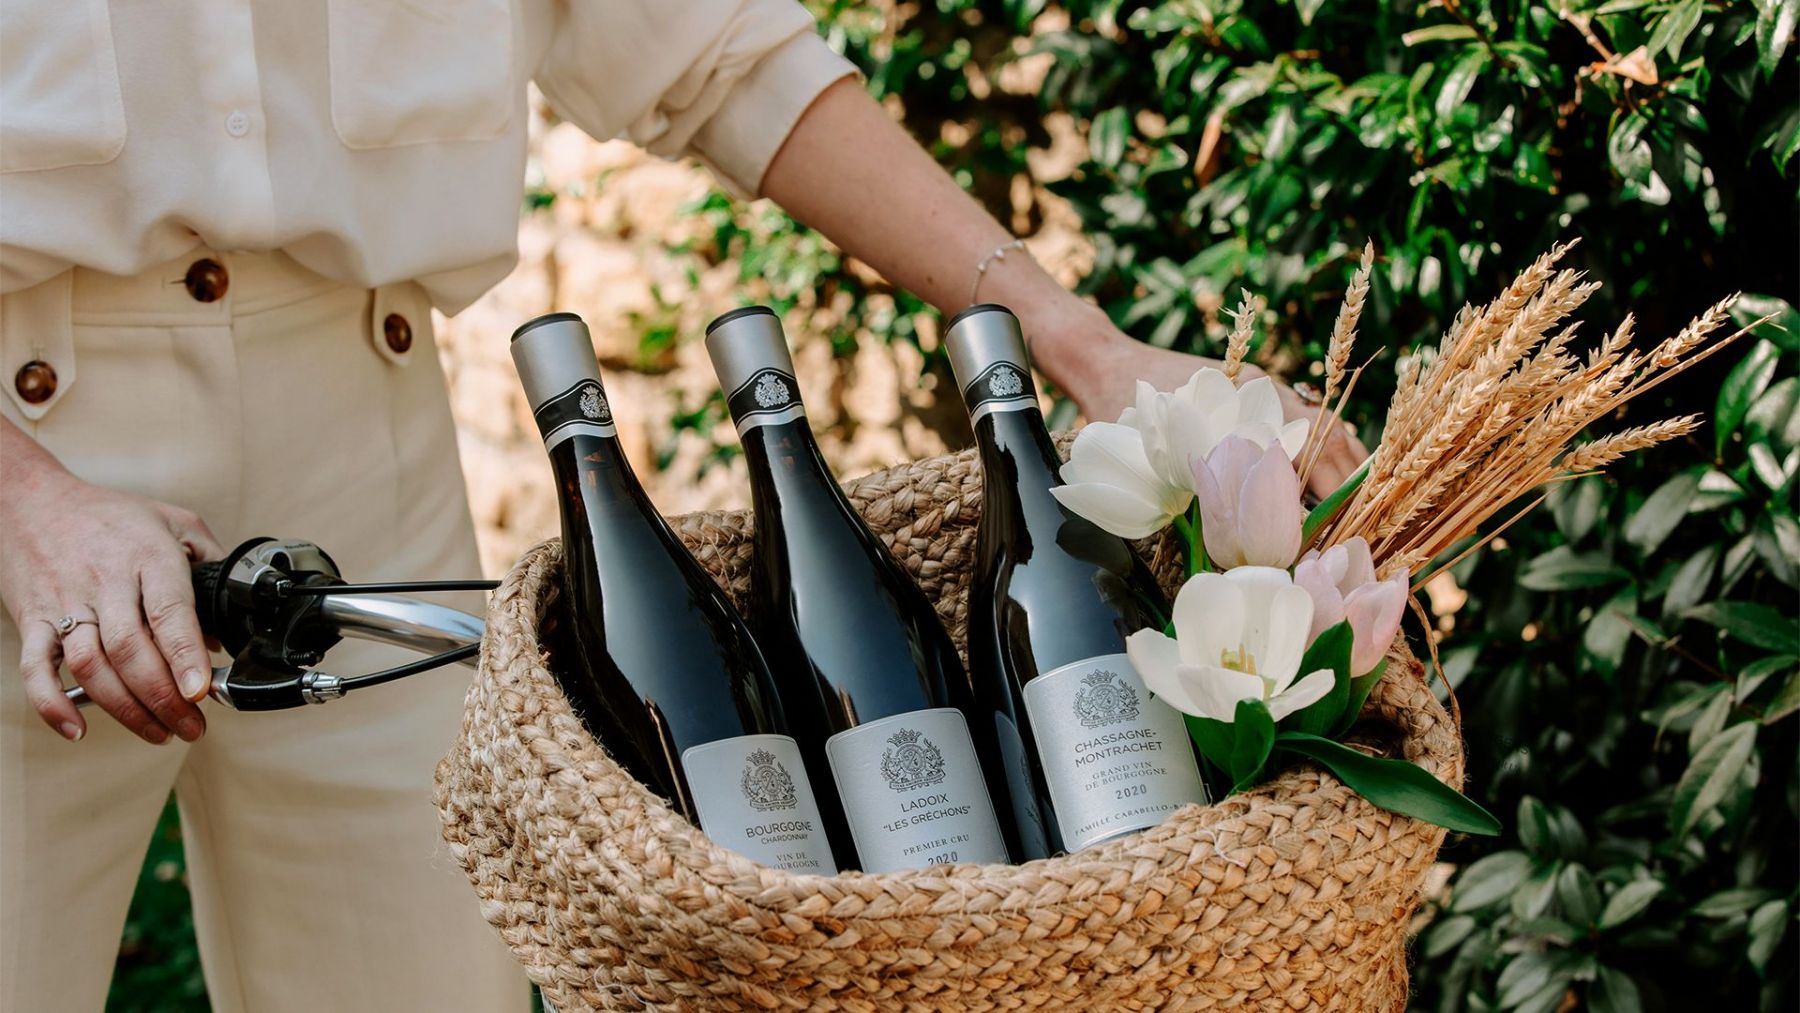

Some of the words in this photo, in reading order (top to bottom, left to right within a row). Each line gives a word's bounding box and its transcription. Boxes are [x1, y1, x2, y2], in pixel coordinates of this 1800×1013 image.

[1075, 729, 1157, 753] CHASSAGNE-
[1075, 741, 1163, 768] MONTRACHET
[1085, 782, 1100, 791] DE
[1103, 767, 1168, 785] BOURGOGNE
[1092, 764, 1130, 780] GRAND
[1132, 761, 1153, 769] VIN
[1115, 783, 1147, 800] 2020
[901, 793, 950, 813] LADOIX
[745, 821, 813, 838] BOURGOGNE
[1075, 816, 1110, 837] FAMILLE
[761, 834, 808, 845] CHARDONNAY
[903, 838, 948, 856] PREMIER
[950, 834, 970, 844] CRU
[773, 860, 820, 870] OURGOGNE
[776, 854, 793, 862] VIN
